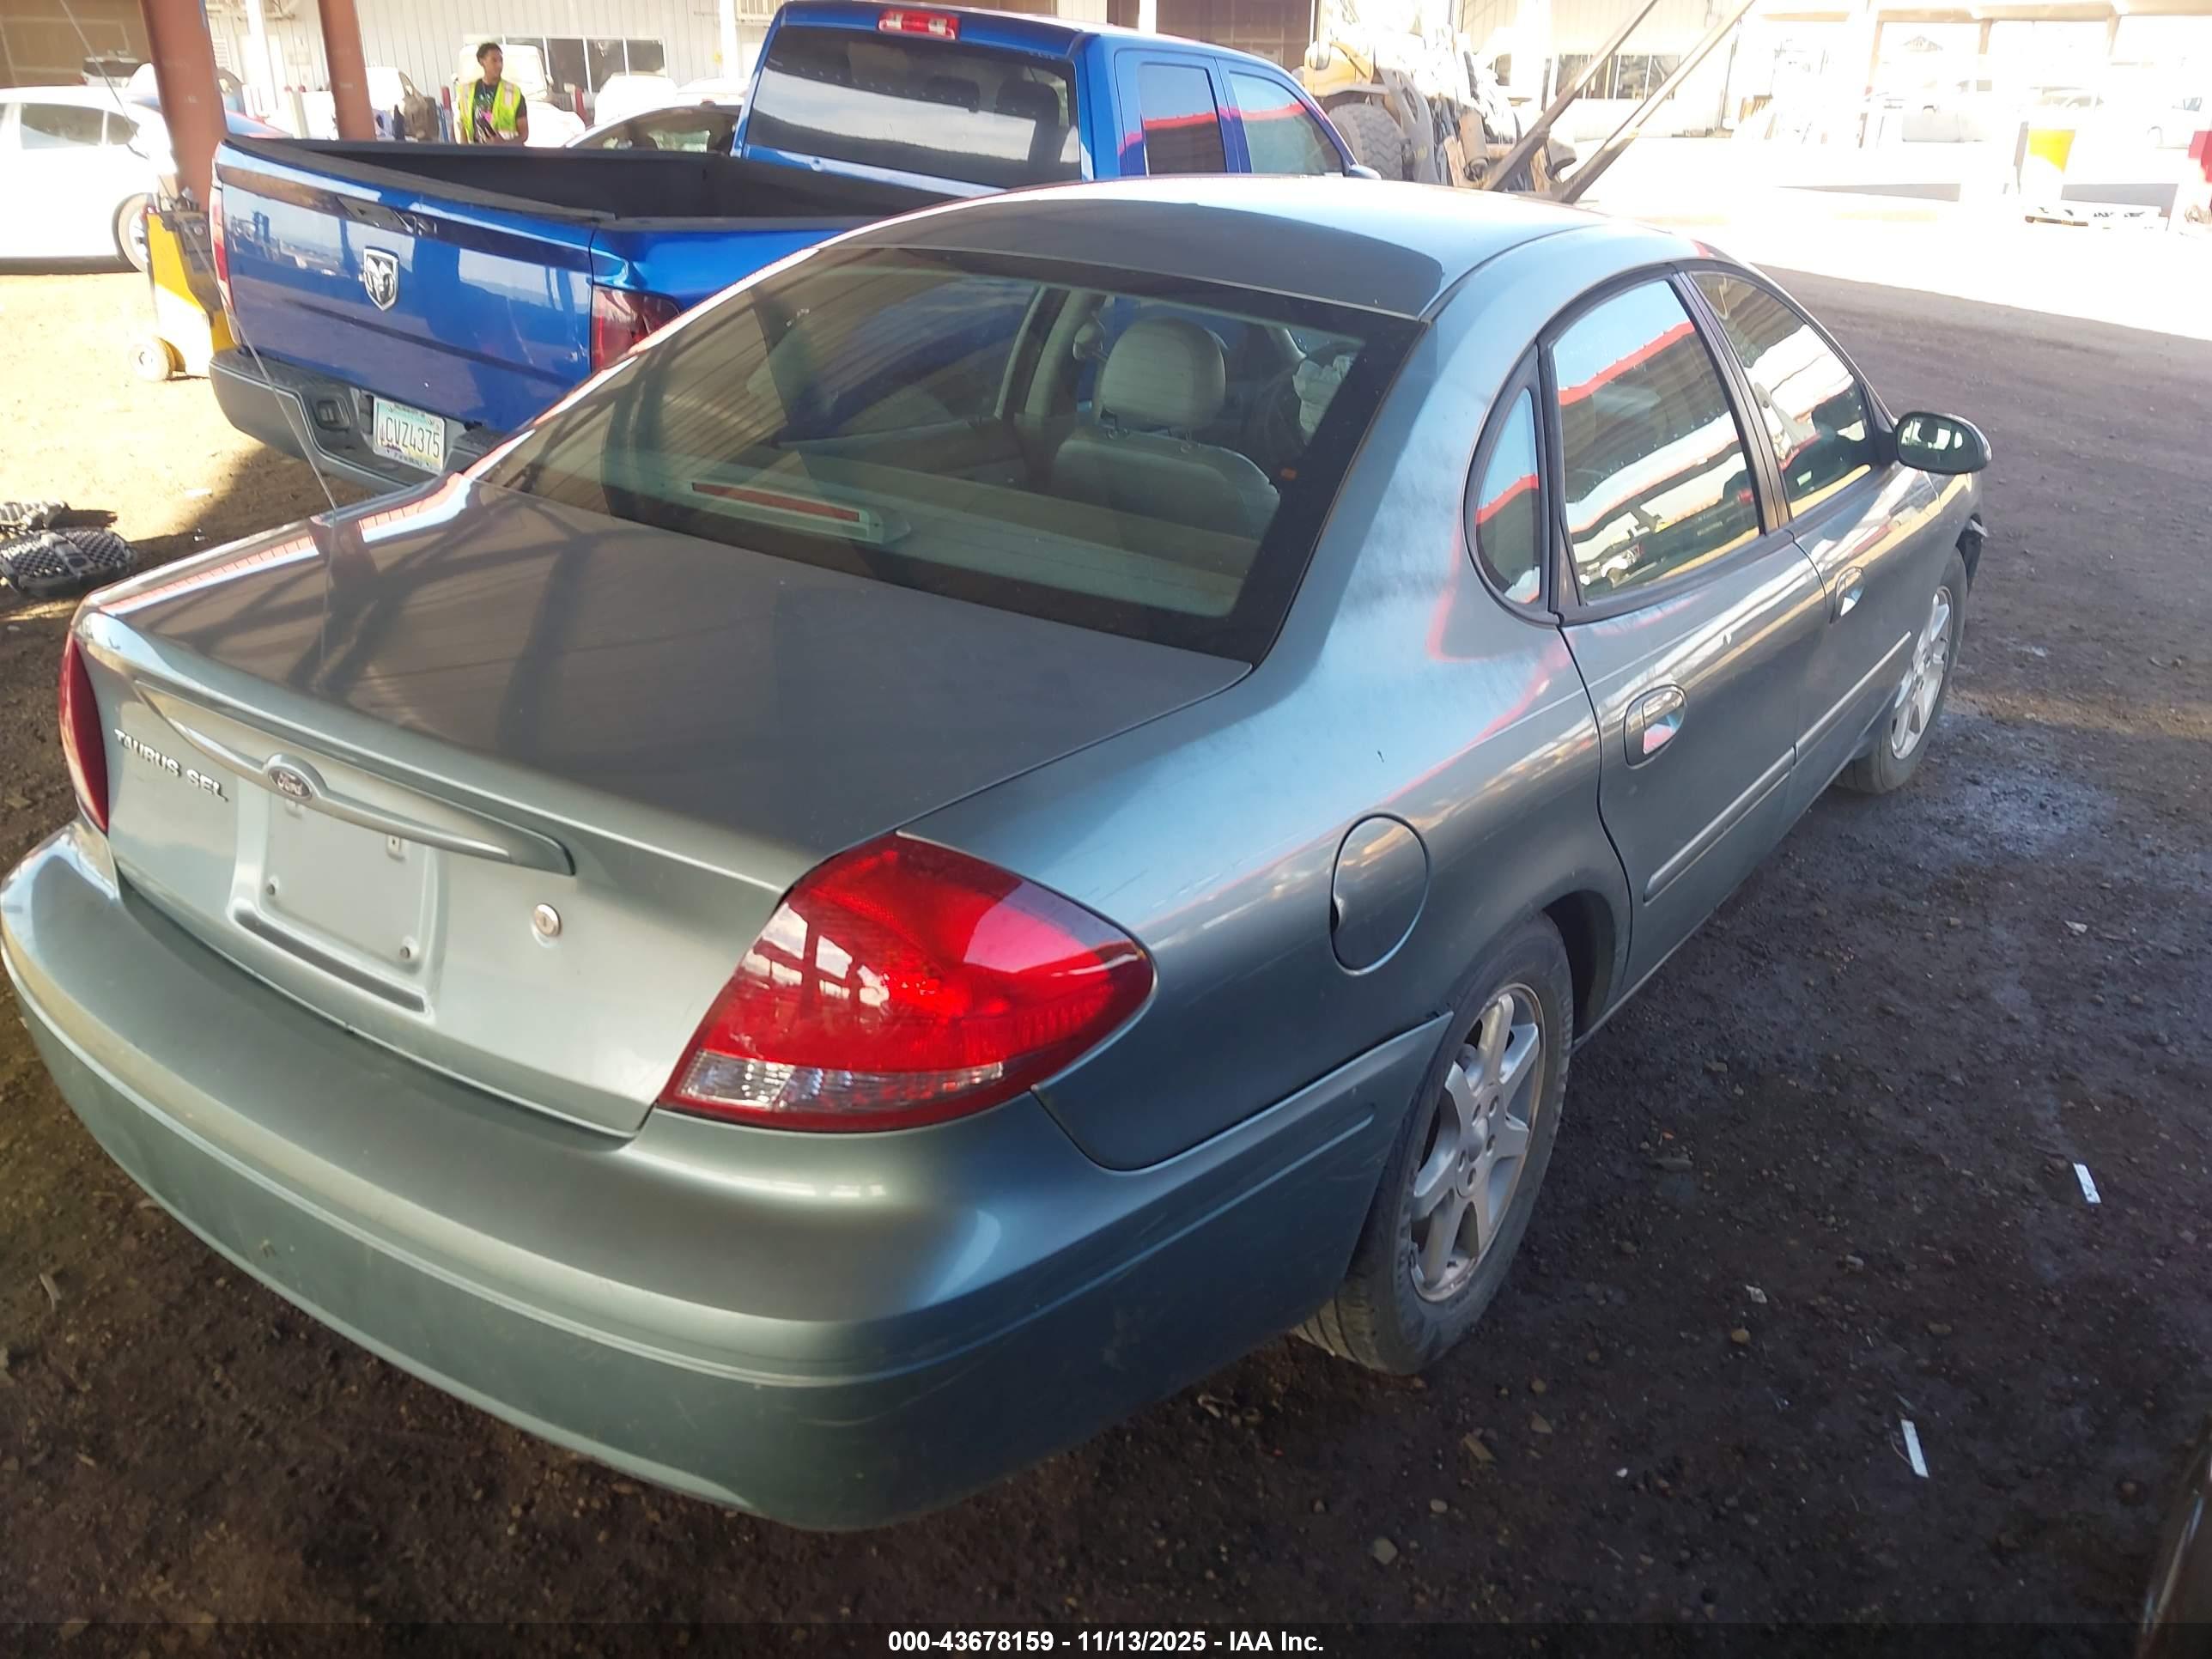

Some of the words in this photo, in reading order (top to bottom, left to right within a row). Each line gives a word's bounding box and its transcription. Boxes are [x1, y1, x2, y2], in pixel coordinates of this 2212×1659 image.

[386, 416, 441, 459] CVZ4375
[113, 728, 181, 777] TAURUS
[186, 769, 229, 802] SEL
[276, 772, 302, 796] Ford
